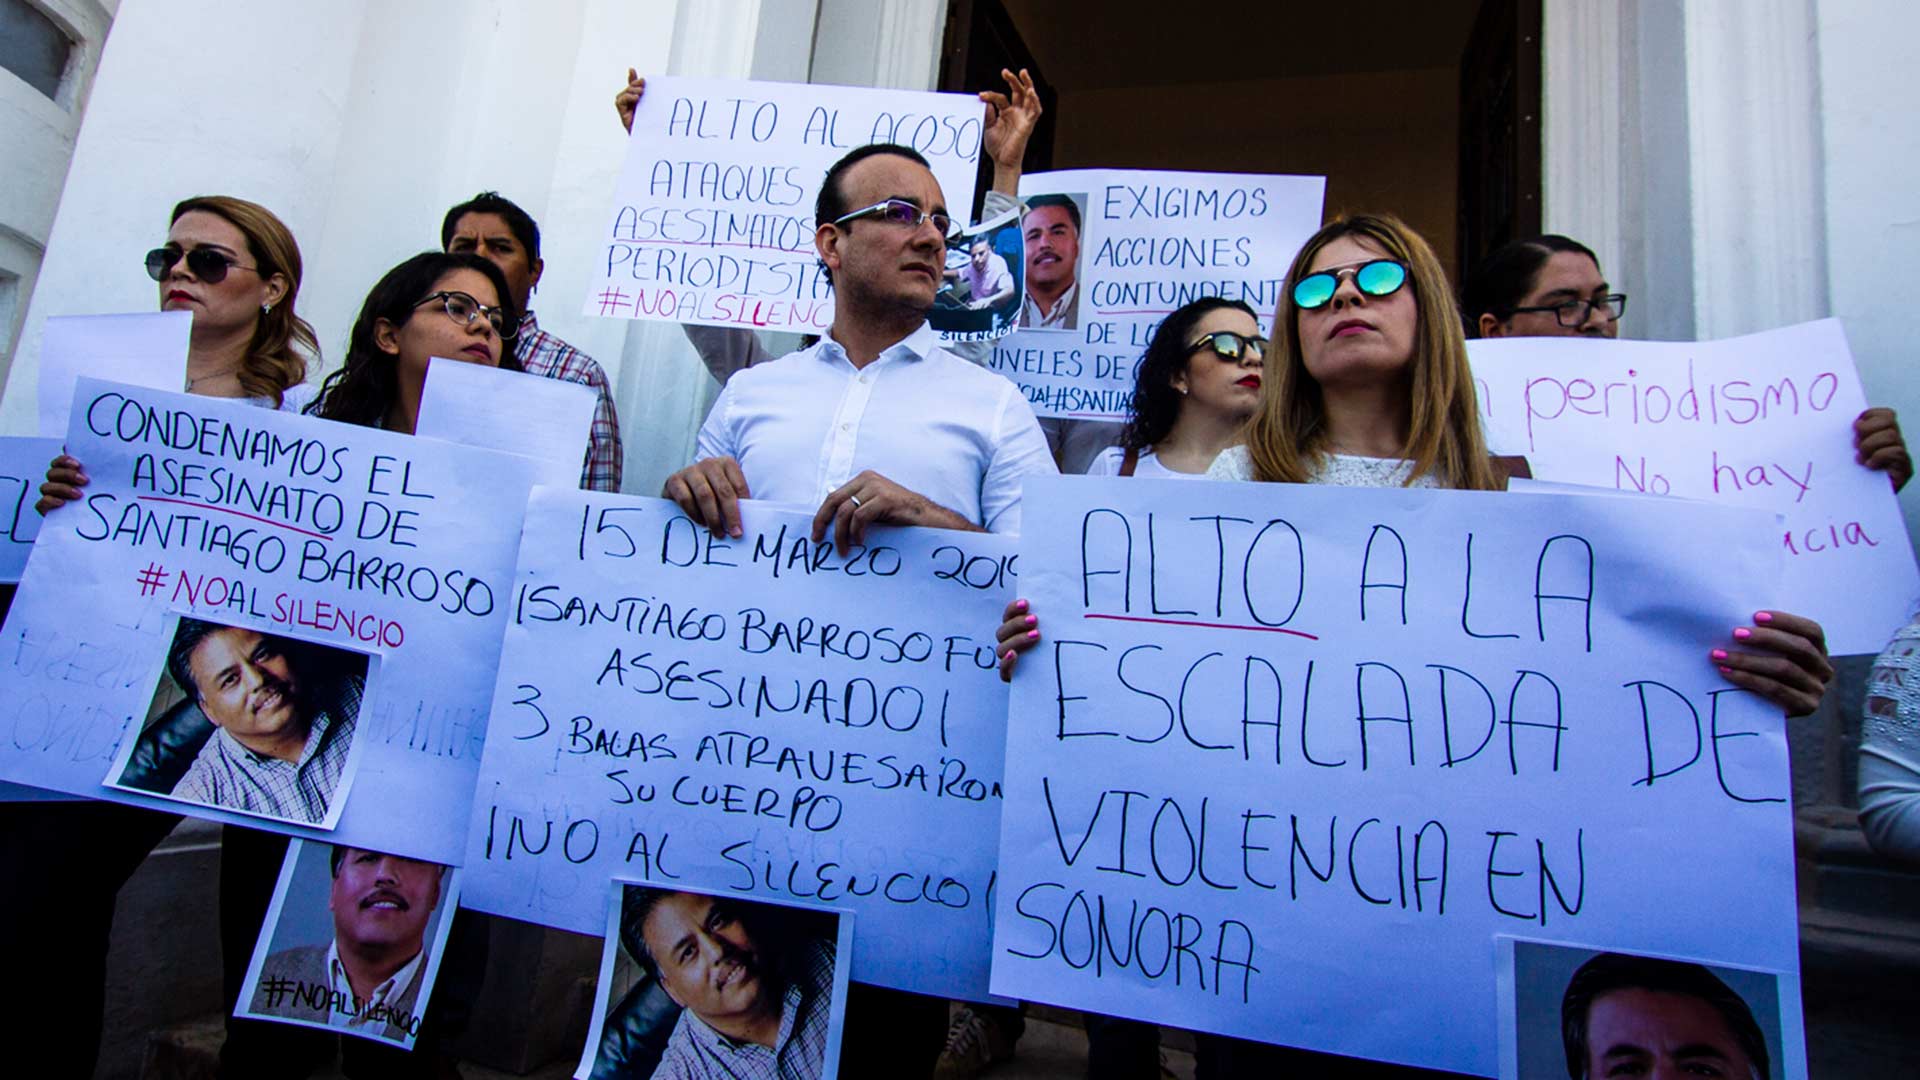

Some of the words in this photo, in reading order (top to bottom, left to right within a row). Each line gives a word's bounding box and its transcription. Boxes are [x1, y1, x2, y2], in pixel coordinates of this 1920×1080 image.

[668, 97, 778, 143] ALTO
[803, 106, 849, 148] AL
[649, 159, 804, 206] ATAQUES
[1103, 185, 1268, 221] EXIGIMOS
[612, 206, 817, 252] ASESINATOS
[1094, 236, 1251, 269] ACCIONES
[606, 244, 834, 299] PERIODISTA
[1091, 279, 1284, 308] CONTUNDENT
[598, 286, 828, 329] #NOALSILENC
[1086, 321, 1117, 345] DE
[1096, 353, 1127, 381] DE
[1524, 358, 1838, 453] periodismo
[87, 392, 349, 483] CONDENAMOS
[369, 456, 435, 499] EL
[132, 454, 344, 534] ASESINATO
[357, 502, 420, 548] DE
[1616, 455, 1670, 496] No
[1713, 451, 1812, 503] hay
[76, 494, 286, 573] SANTIAGO
[298, 541, 495, 616] BARROSO
[579, 505, 642, 561] 15
[662, 515, 738, 567] DE
[753, 524, 901, 578] MARZO
[1783, 521, 1880, 555] icia
[137, 561, 405, 648] #NOALSILENCIO
[1082, 508, 1304, 629] ALTO
[1360, 524, 1407, 626] A
[1463, 532, 1593, 652] LA
[739, 607, 933, 663] BARROSO
[944, 636, 1000, 672] FU
[512, 684, 550, 740] 3
[567, 716, 678, 760] BALAS
[1055, 640, 1568, 776] ESCALADA
[1623, 681, 1787, 803] DE
[606, 770, 655, 806] SU
[672, 775, 842, 832] CUERPO
[626, 832, 680, 880] AL
[1043, 776, 1449, 916] VIOLENCIA
[1486, 829, 1584, 927] EN
[1006, 880, 1261, 1004] SONORA
